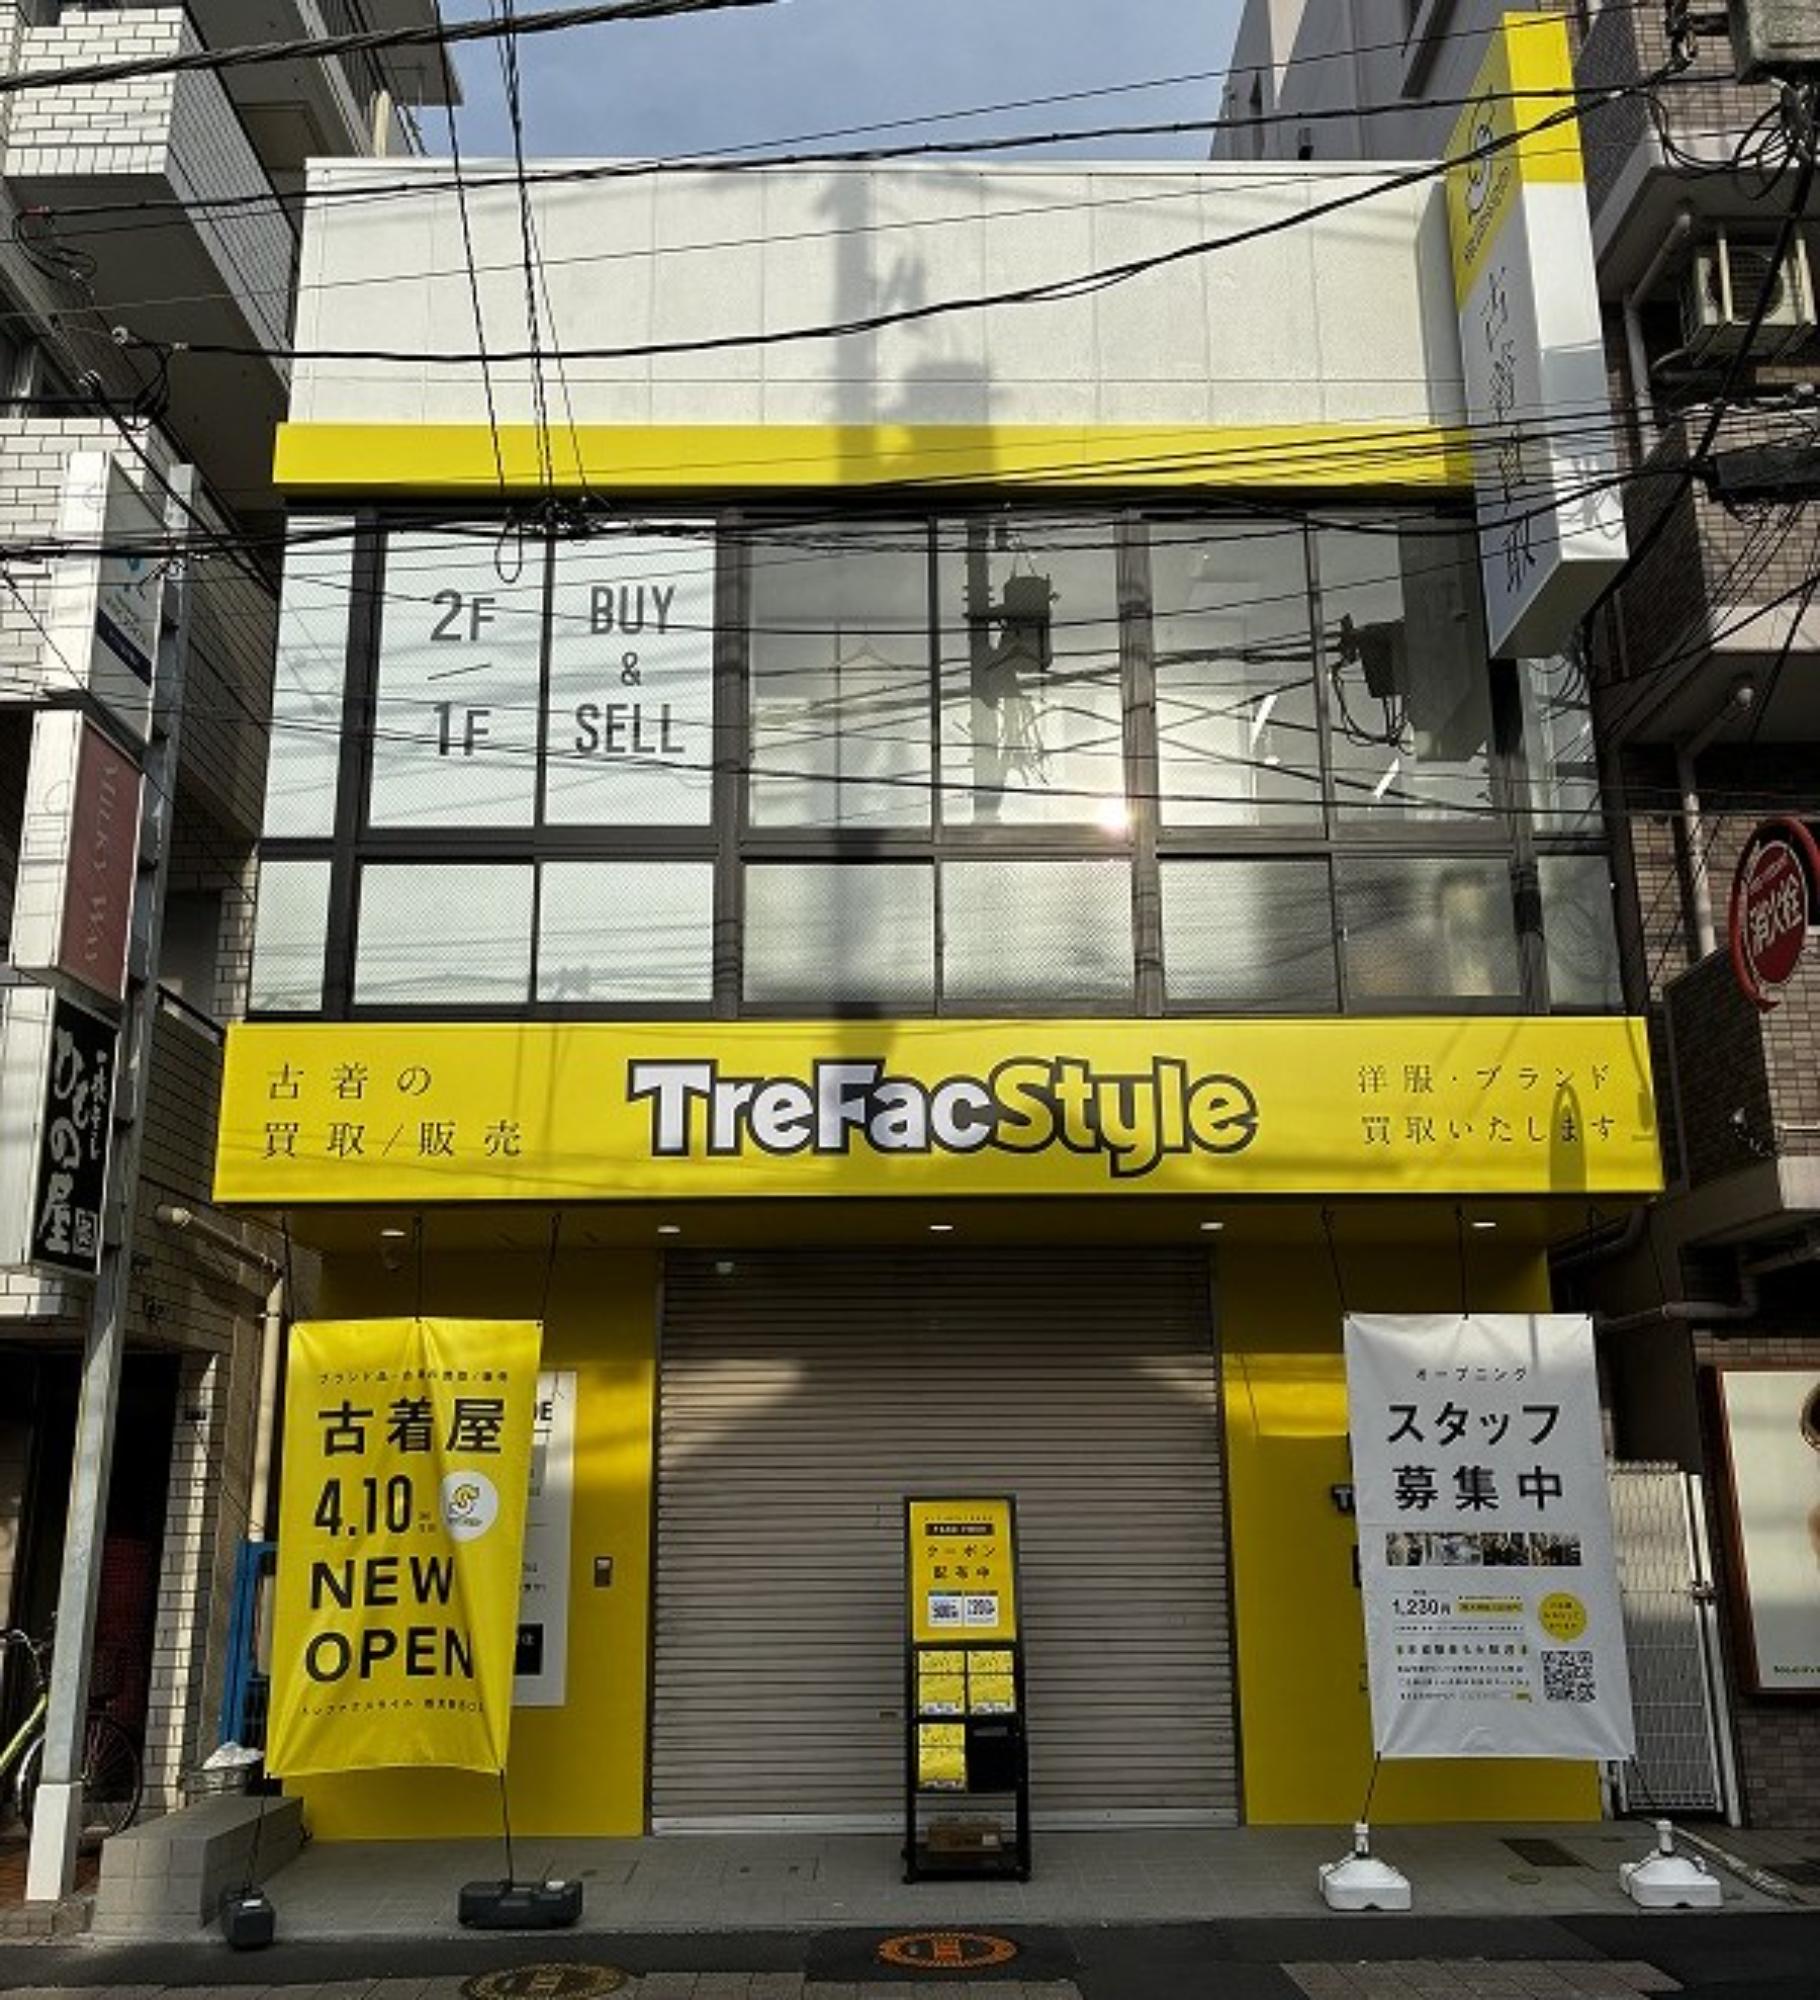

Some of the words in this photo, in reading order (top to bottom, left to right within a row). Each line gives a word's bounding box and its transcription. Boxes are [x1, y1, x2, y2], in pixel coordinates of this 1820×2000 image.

[430, 589, 495, 641] 2F
[591, 585, 676, 635] BUY
[621, 652, 641, 685] &
[434, 702, 490, 756] 1F
[576, 704, 685, 753] SELL
[268, 1062, 432, 1100] 古着の
[1359, 1063, 1611, 1094] 洋服・ブランド
[263, 1119, 524, 1159] 買取/販売
[1361, 1114, 1616, 1145] 買取いたします
[1415, 1367, 1528, 1382] オープニング
[318, 1396, 504, 1455] 古着屋
[1387, 1401, 1560, 1446] スタッフ
[314, 1475, 412, 1537] 4.10
[1392, 1464, 1563, 1511] 募集中
[311, 1556, 454, 1609] NEW
[305, 1627, 474, 1683] OPEN
